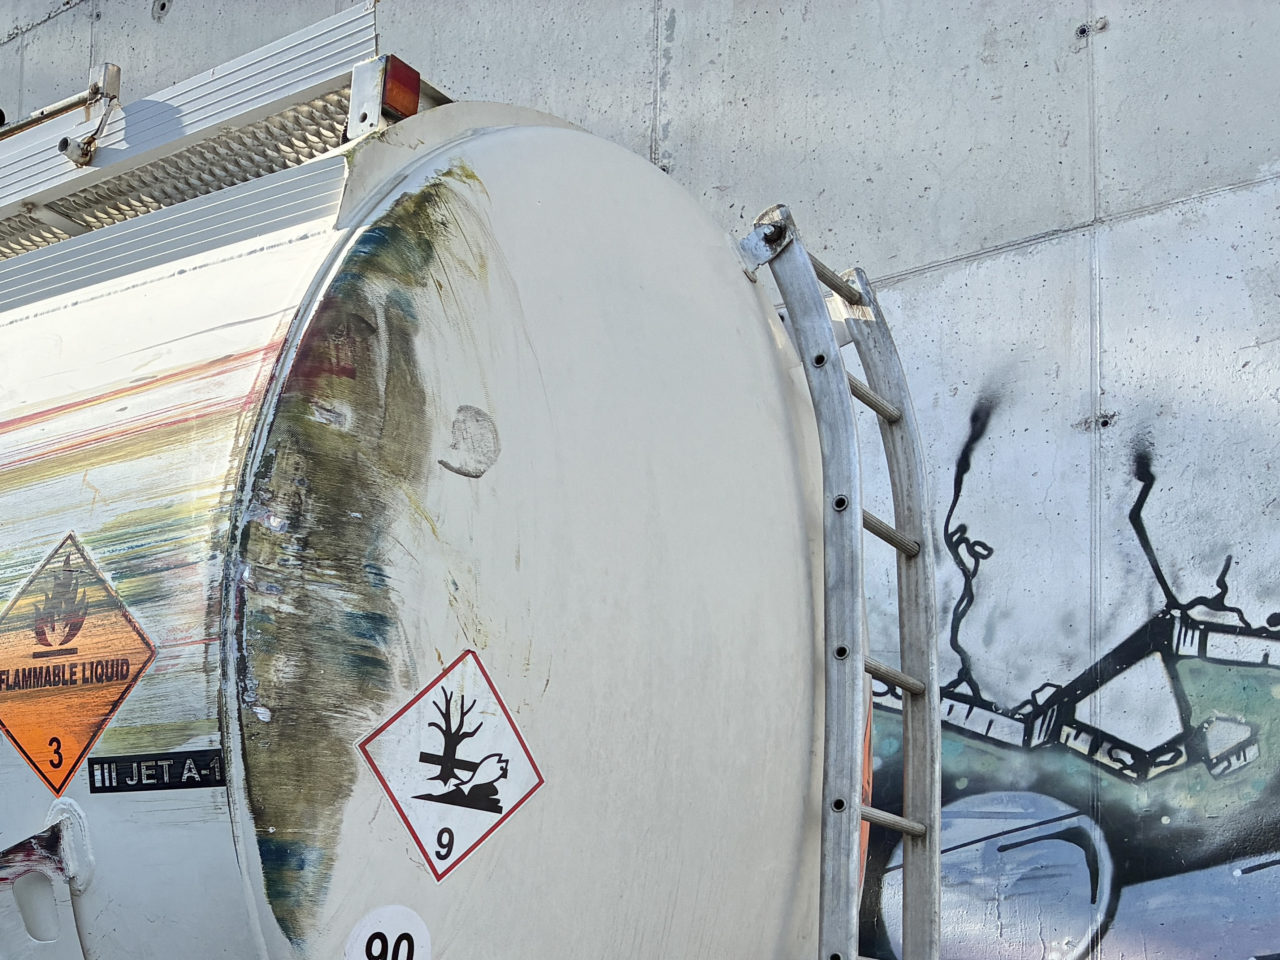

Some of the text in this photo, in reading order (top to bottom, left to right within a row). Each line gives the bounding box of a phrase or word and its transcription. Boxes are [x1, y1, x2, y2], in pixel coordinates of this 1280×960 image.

[82, 658, 130, 684] LIQUID
[48, 737, 63, 769] 3
[125, 760, 173, 785] JET
[181, 757, 220, 781] A-1
[434, 827, 454, 860] 9
